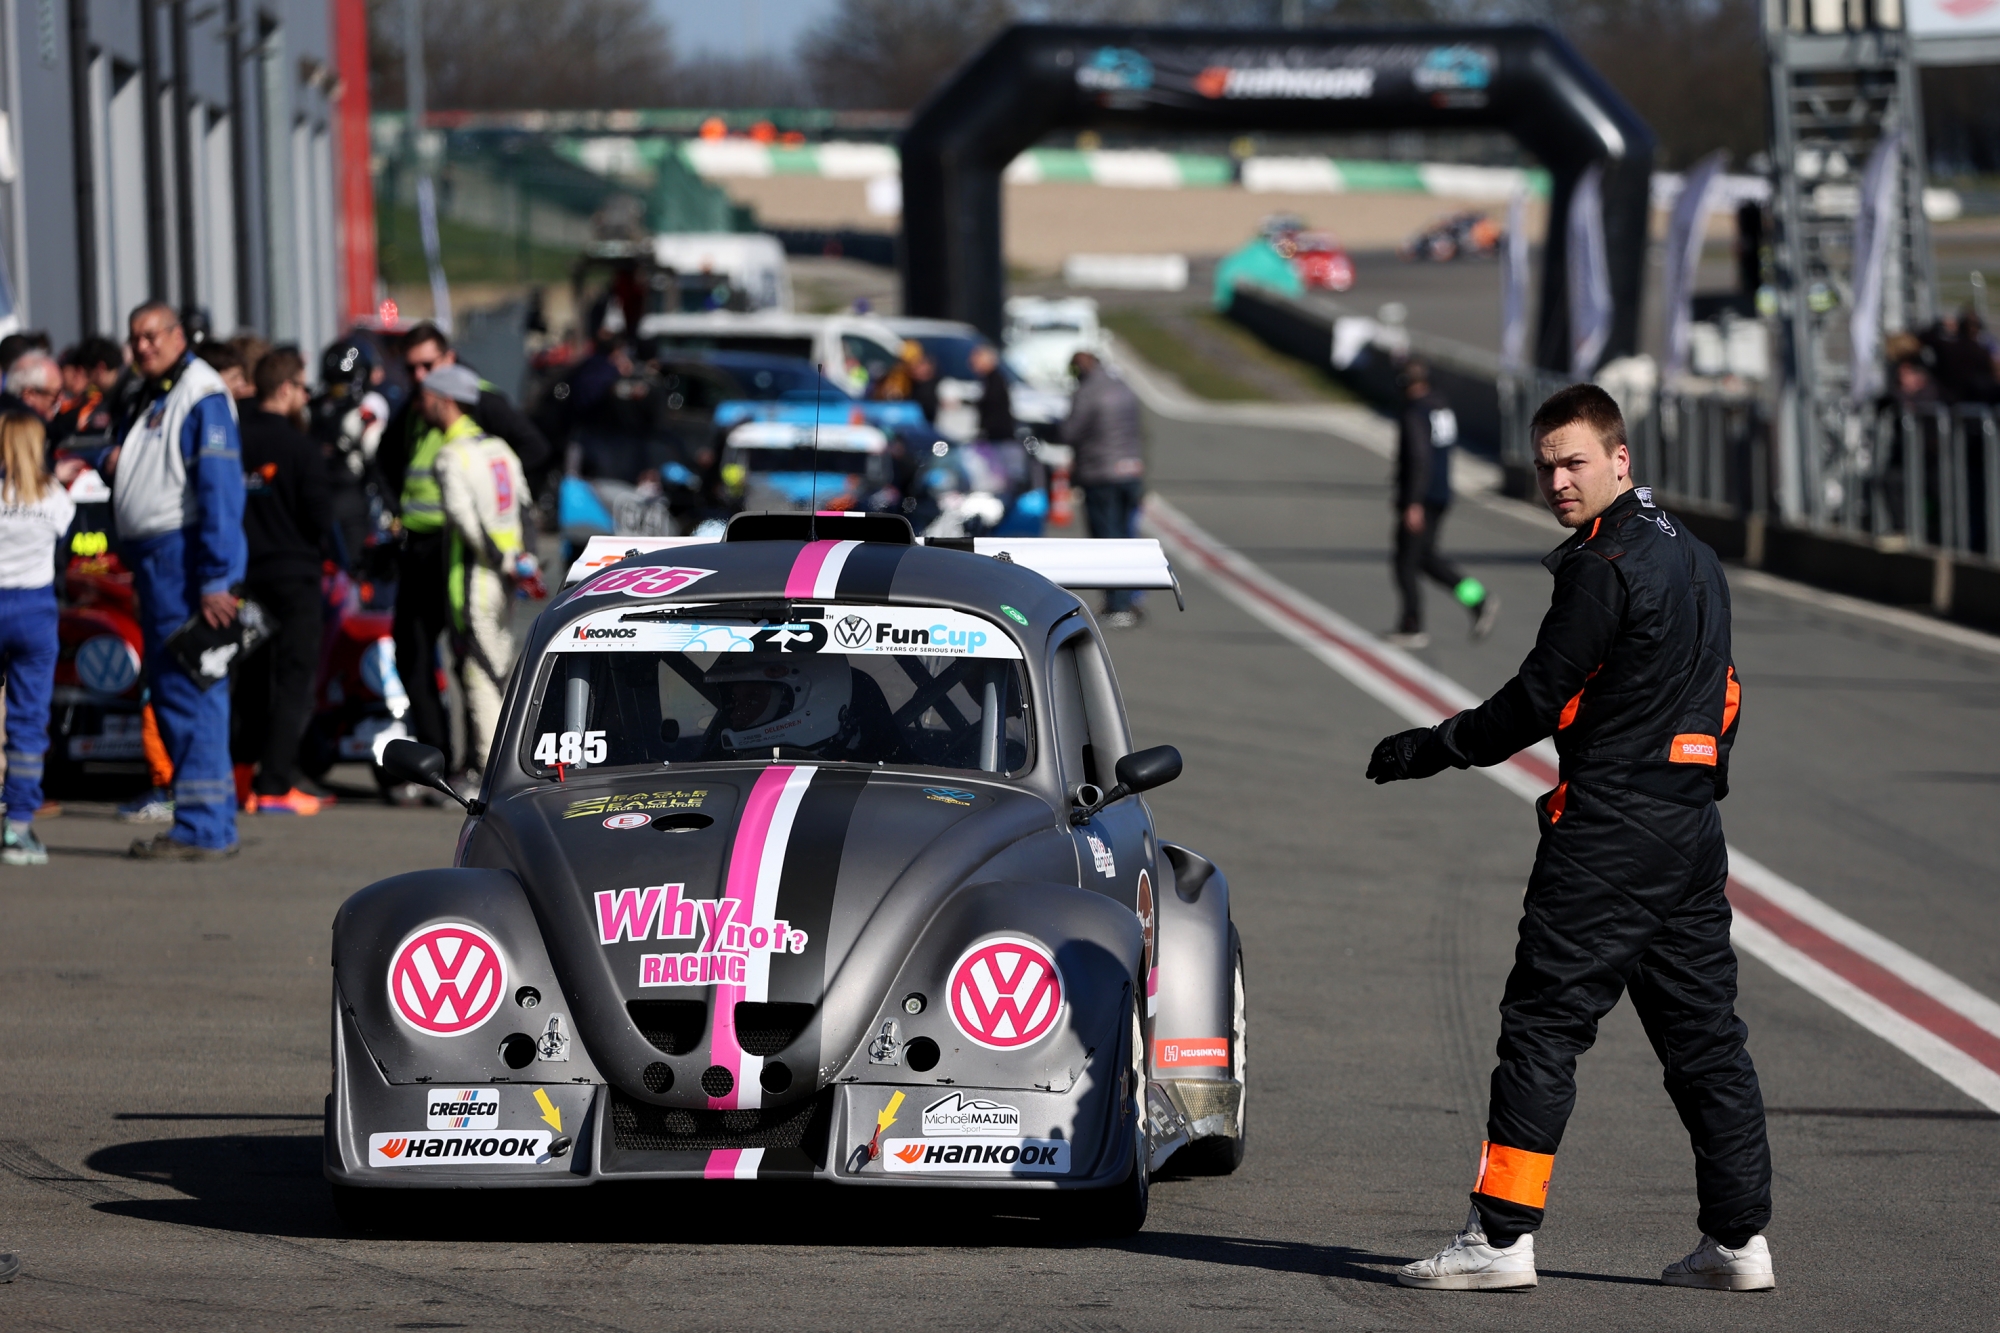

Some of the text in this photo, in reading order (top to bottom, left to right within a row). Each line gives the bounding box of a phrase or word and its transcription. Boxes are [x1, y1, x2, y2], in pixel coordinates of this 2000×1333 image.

[573, 622, 637, 640] KRONOS
[876, 623, 987, 654] FunCup
[534, 730, 608, 765] 485
[1682, 744, 1714, 754] sparco
[642, 954, 746, 985] RACING
[429, 1102, 498, 1116] CREDECO
[961, 1125, 981, 1133] Sport
